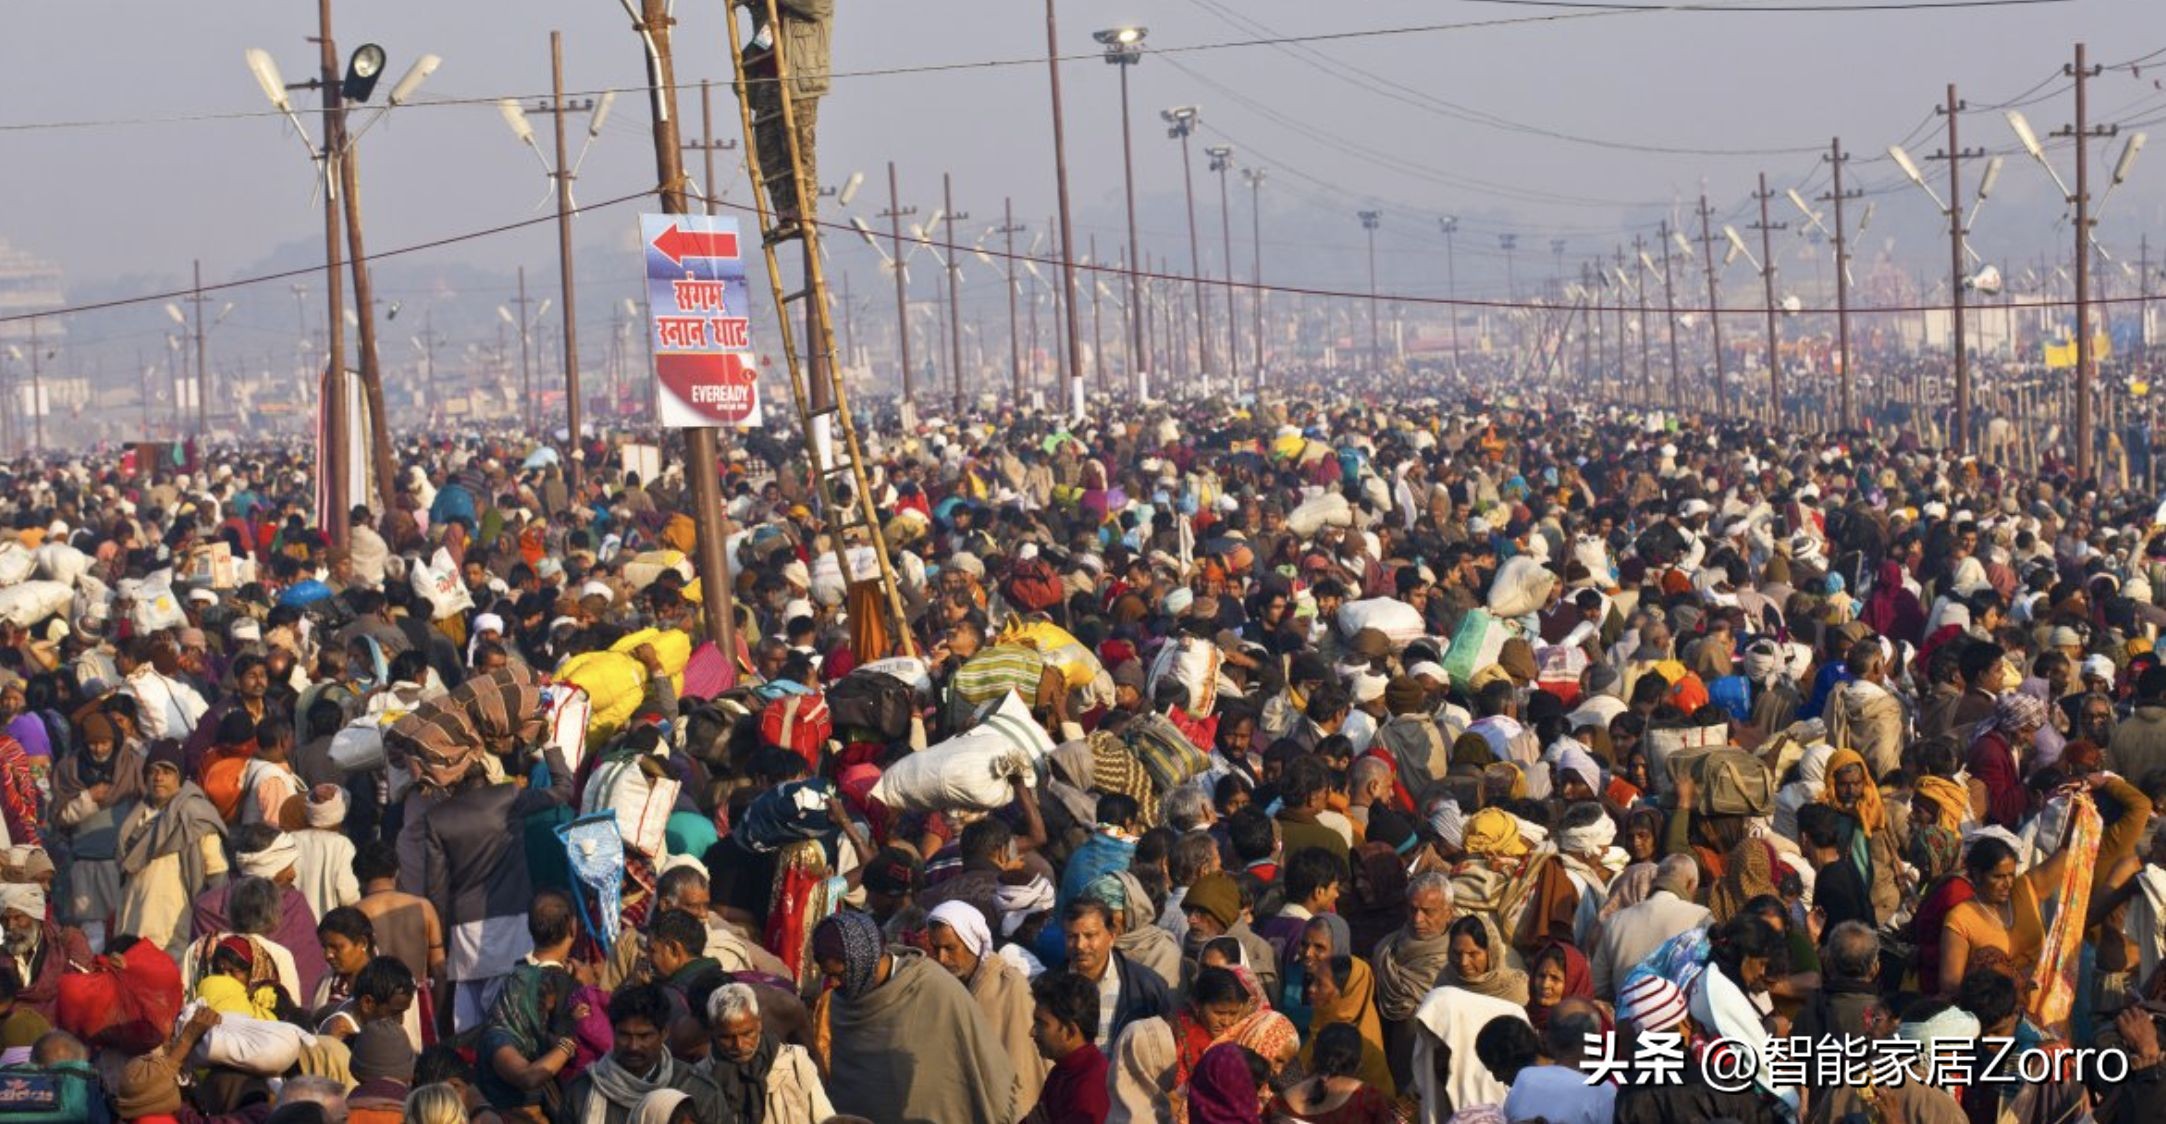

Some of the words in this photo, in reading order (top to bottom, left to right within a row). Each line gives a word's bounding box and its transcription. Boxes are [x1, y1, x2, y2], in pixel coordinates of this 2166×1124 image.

[672, 270, 725, 312] संगम
[710, 316, 749, 348] घाट
[691, 384, 748, 403] EVEREADY
